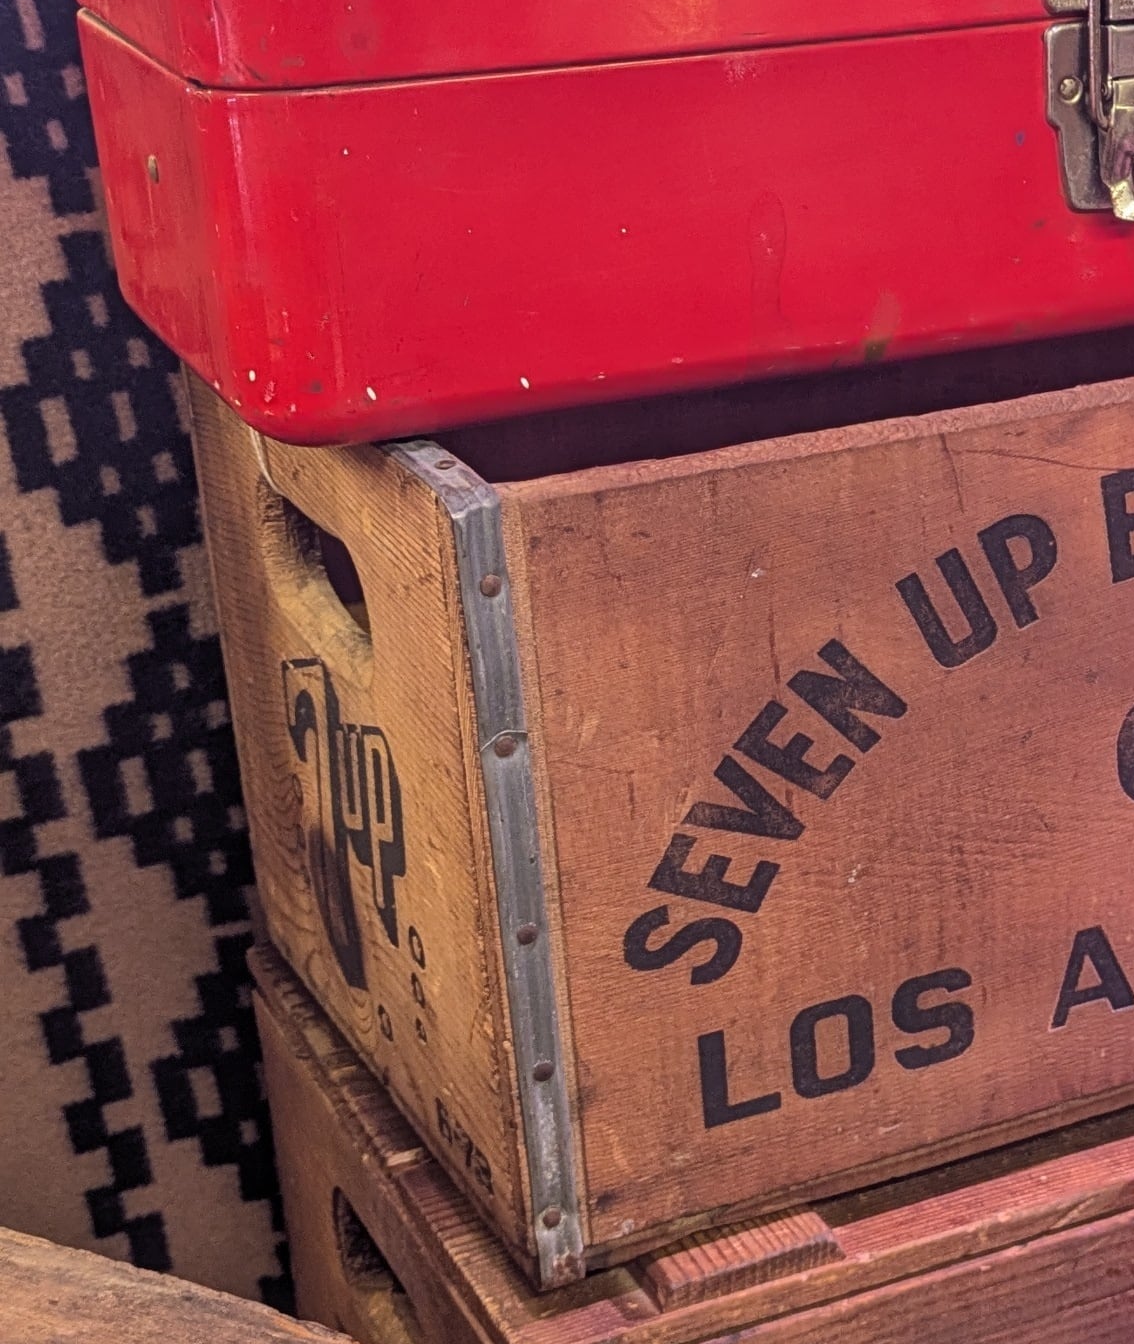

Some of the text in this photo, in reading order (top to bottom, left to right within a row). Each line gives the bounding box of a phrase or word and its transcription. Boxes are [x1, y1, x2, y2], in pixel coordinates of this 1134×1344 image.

[622, 637, 908, 986] SEVEN
[895, 513, 1058, 669] UP
[697, 966, 976, 1131] LOS
